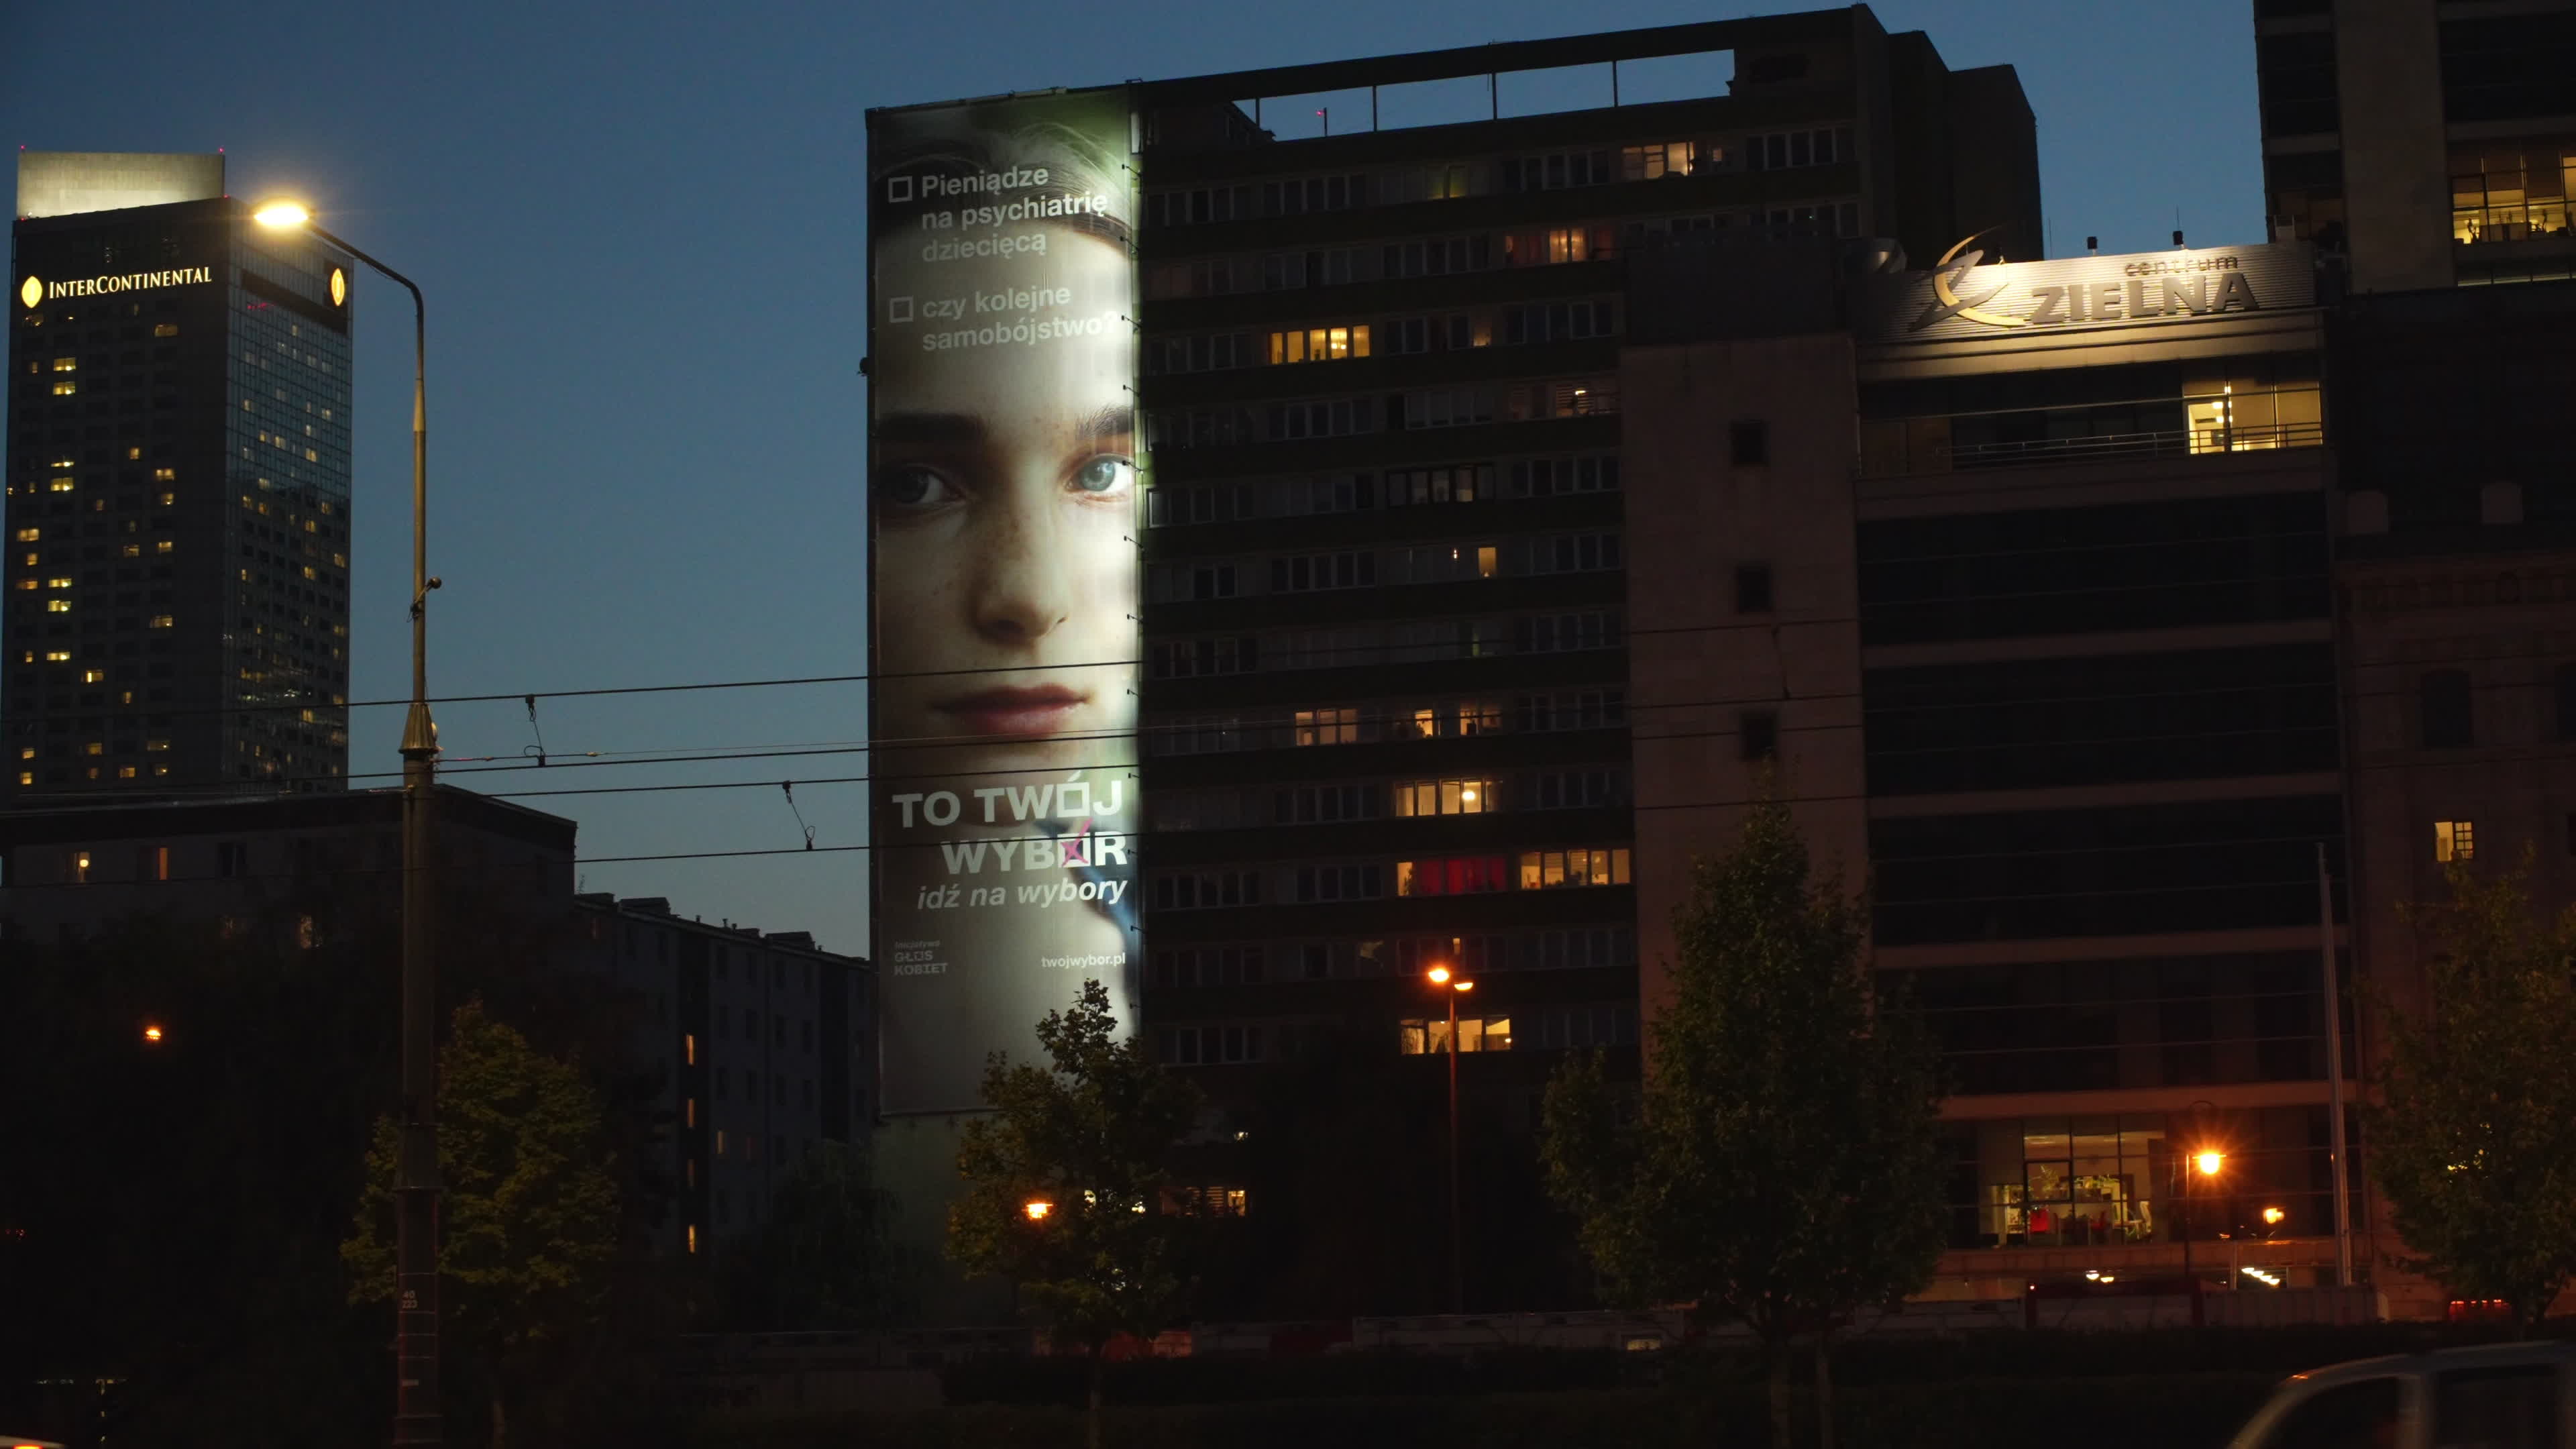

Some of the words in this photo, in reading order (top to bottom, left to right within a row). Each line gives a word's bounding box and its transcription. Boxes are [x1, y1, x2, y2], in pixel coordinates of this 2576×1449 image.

[922, 166, 1049, 197] Pieniądze
[922, 212, 953, 229] na
[962, 191, 1108, 230] psychiatrię
[922, 233, 1046, 262] dziecięcą
[2125, 255, 2238, 276] centrum
[922, 298, 967, 320] czy
[975, 286, 1071, 313] kolejne
[2031, 272, 2260, 324] ZIELNA
[922, 311, 1118, 351] samobójstwo?
[892, 790, 961, 828] TO
[973, 770, 1123, 823] TWÓJ
[917, 883, 960, 910] idź
[969, 885, 1006, 907] na
[1017, 877, 1128, 908] wybory
[894, 962, 949, 976] KOBIET
[1041, 953, 1126, 970] twojwybor.pl
